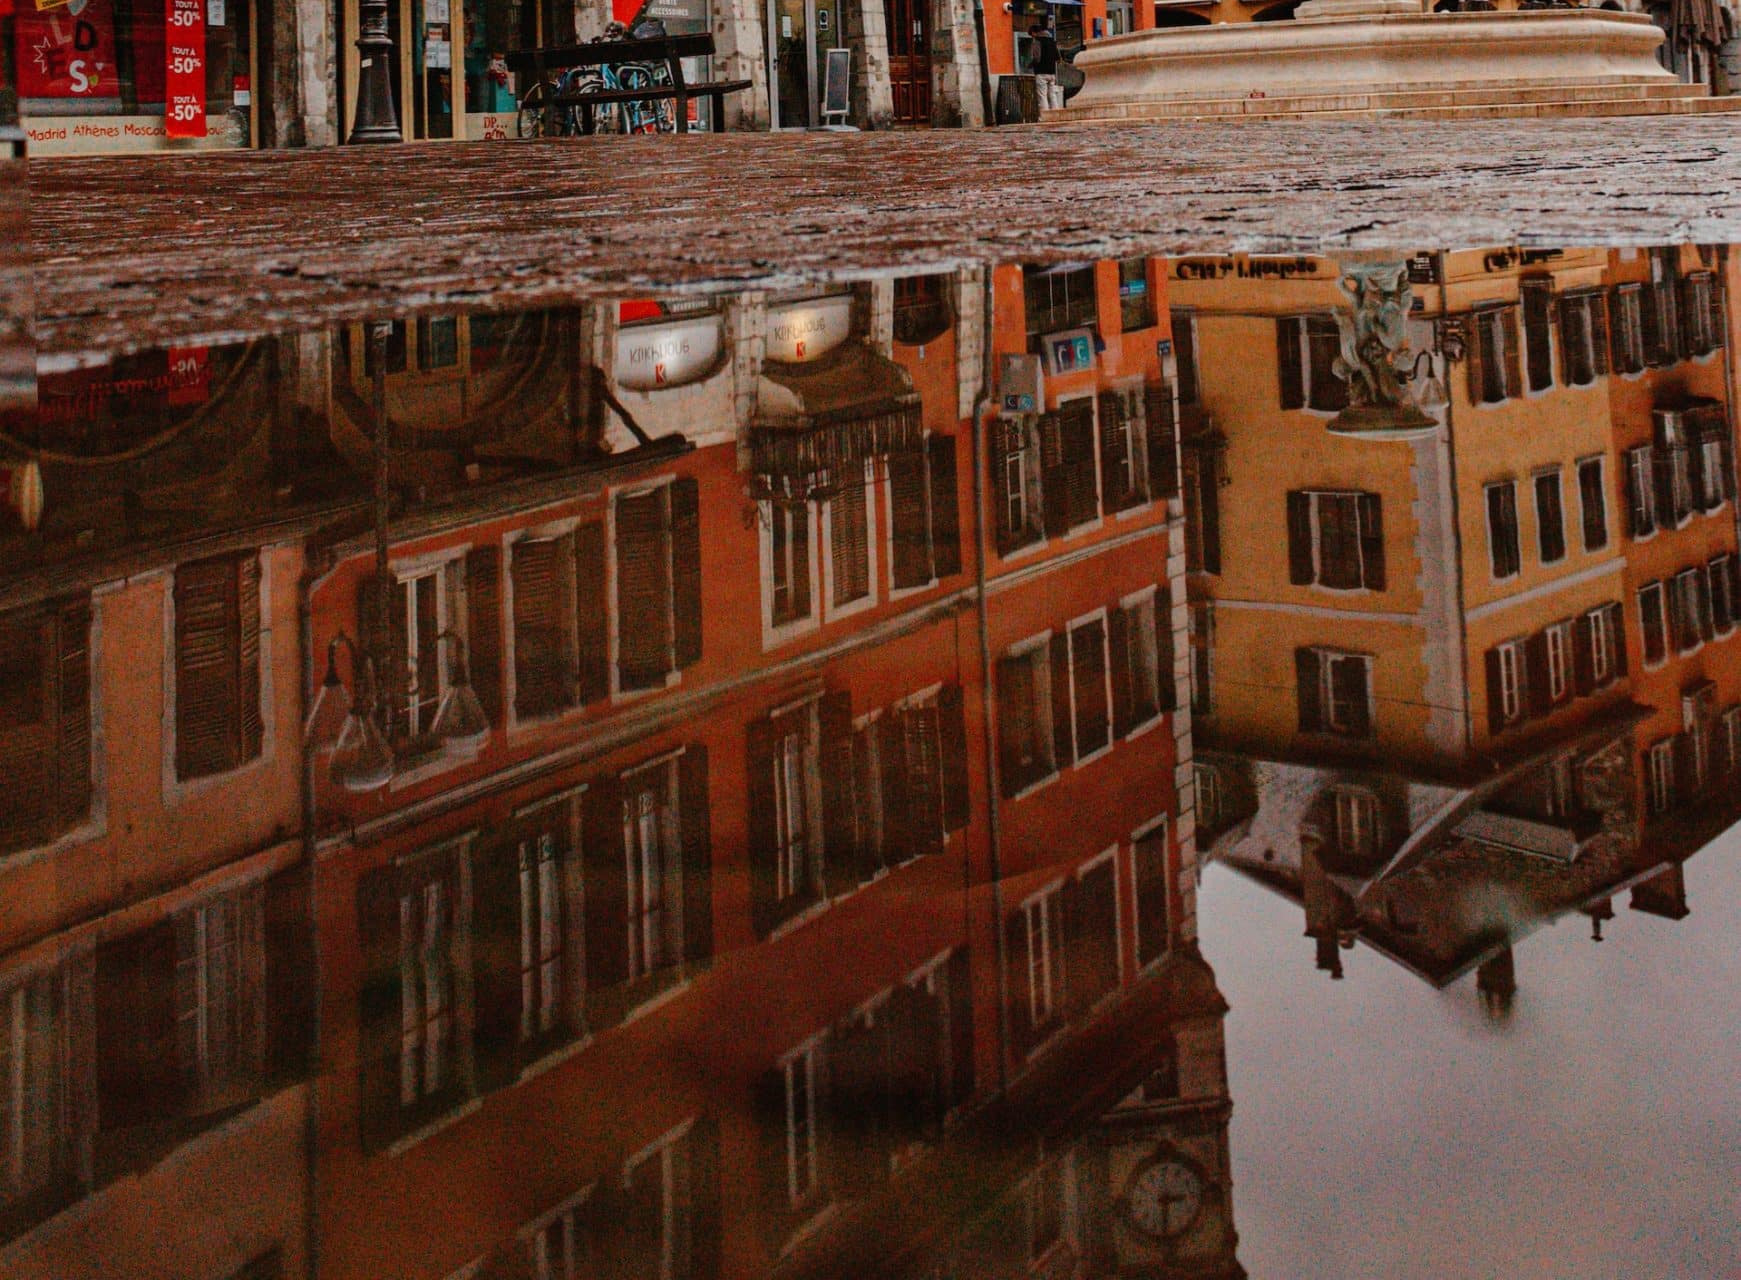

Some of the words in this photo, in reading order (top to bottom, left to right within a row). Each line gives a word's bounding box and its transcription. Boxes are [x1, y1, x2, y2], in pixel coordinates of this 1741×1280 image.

[175, 0, 193, 8] TOUT
[168, 11, 201, 26] -50%
[172, 47, 189, 56] TOUT
[168, 58, 201, 73] -50%
[173, 96, 190, 104] TOUT
[168, 104, 202, 120] -50%
[28, 128, 66, 141] Madrid
[73, 124, 119, 137] Athènes
